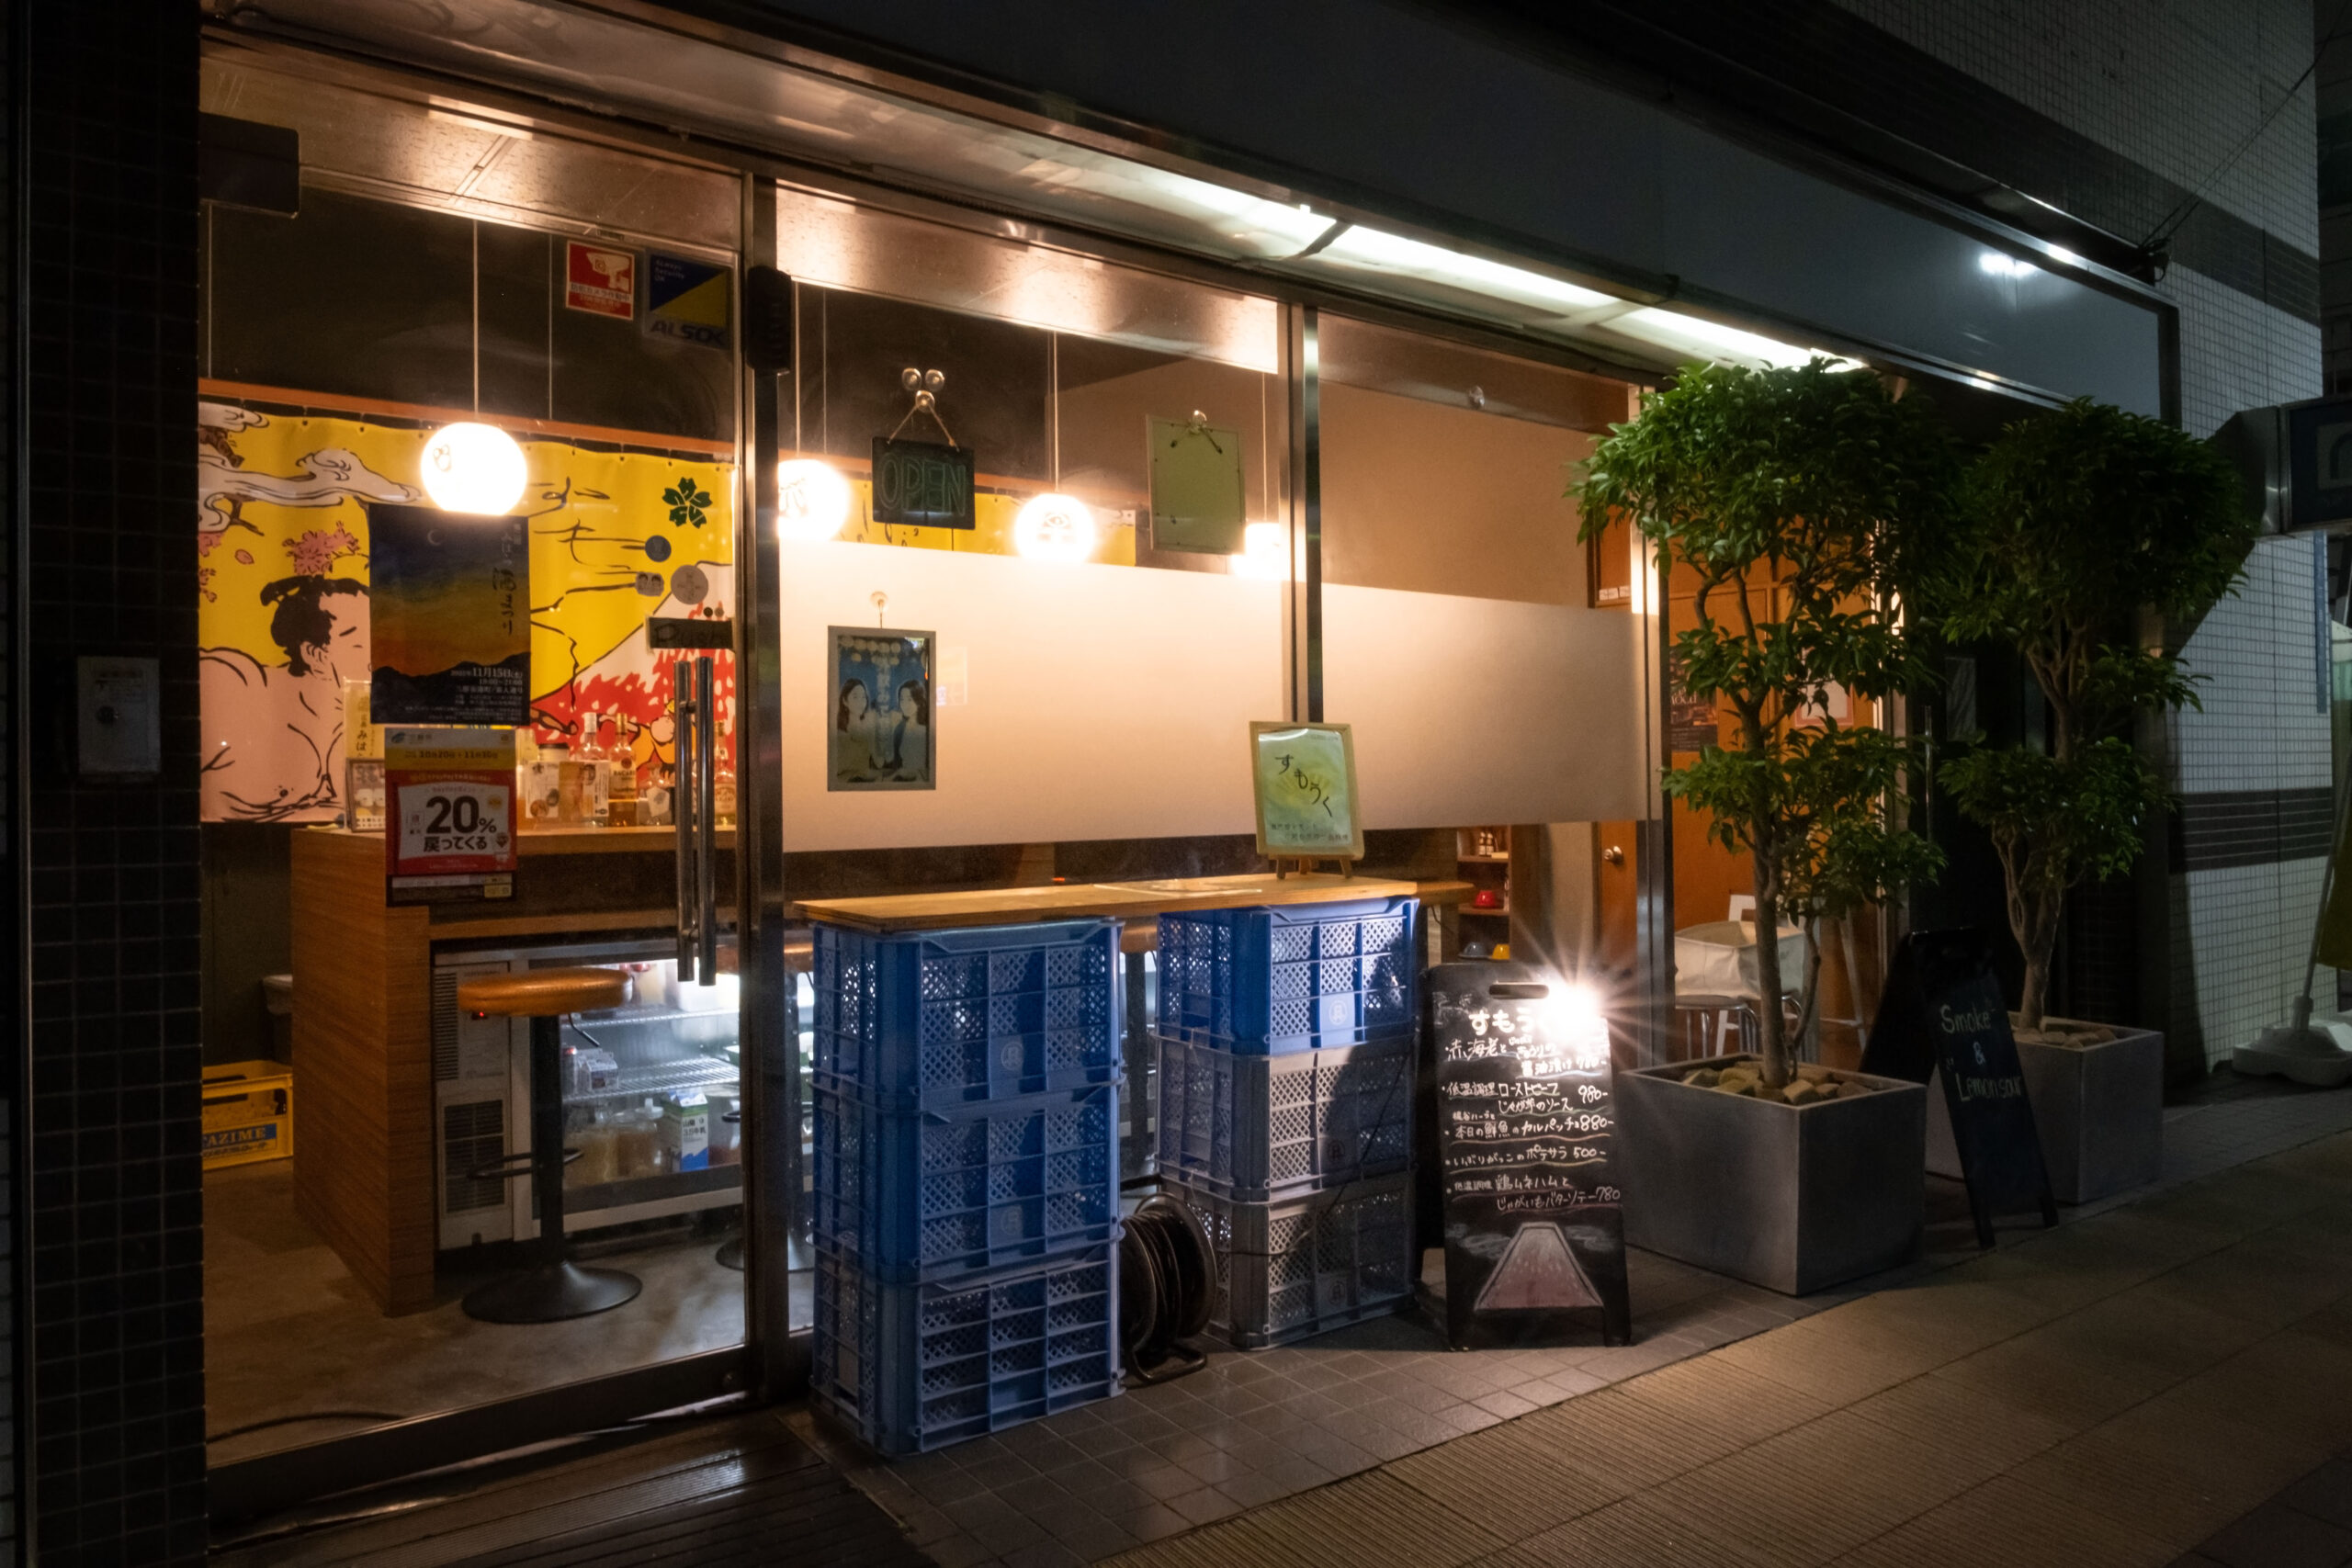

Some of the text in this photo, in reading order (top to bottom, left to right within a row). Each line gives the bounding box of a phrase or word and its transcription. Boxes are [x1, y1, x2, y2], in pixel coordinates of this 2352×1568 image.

[650, 319, 726, 345] ALSOK
[877, 451, 967, 517] OPEN
[1274, 753, 1333, 818] すもうく
[425, 795, 497, 834] 20%
[423, 836, 488, 852] 戻ってくる
[1469, 1007, 1542, 1036] すもう
[1939, 1000, 1992, 1034] Smoke
[1973, 1041, 1986, 1065] &
